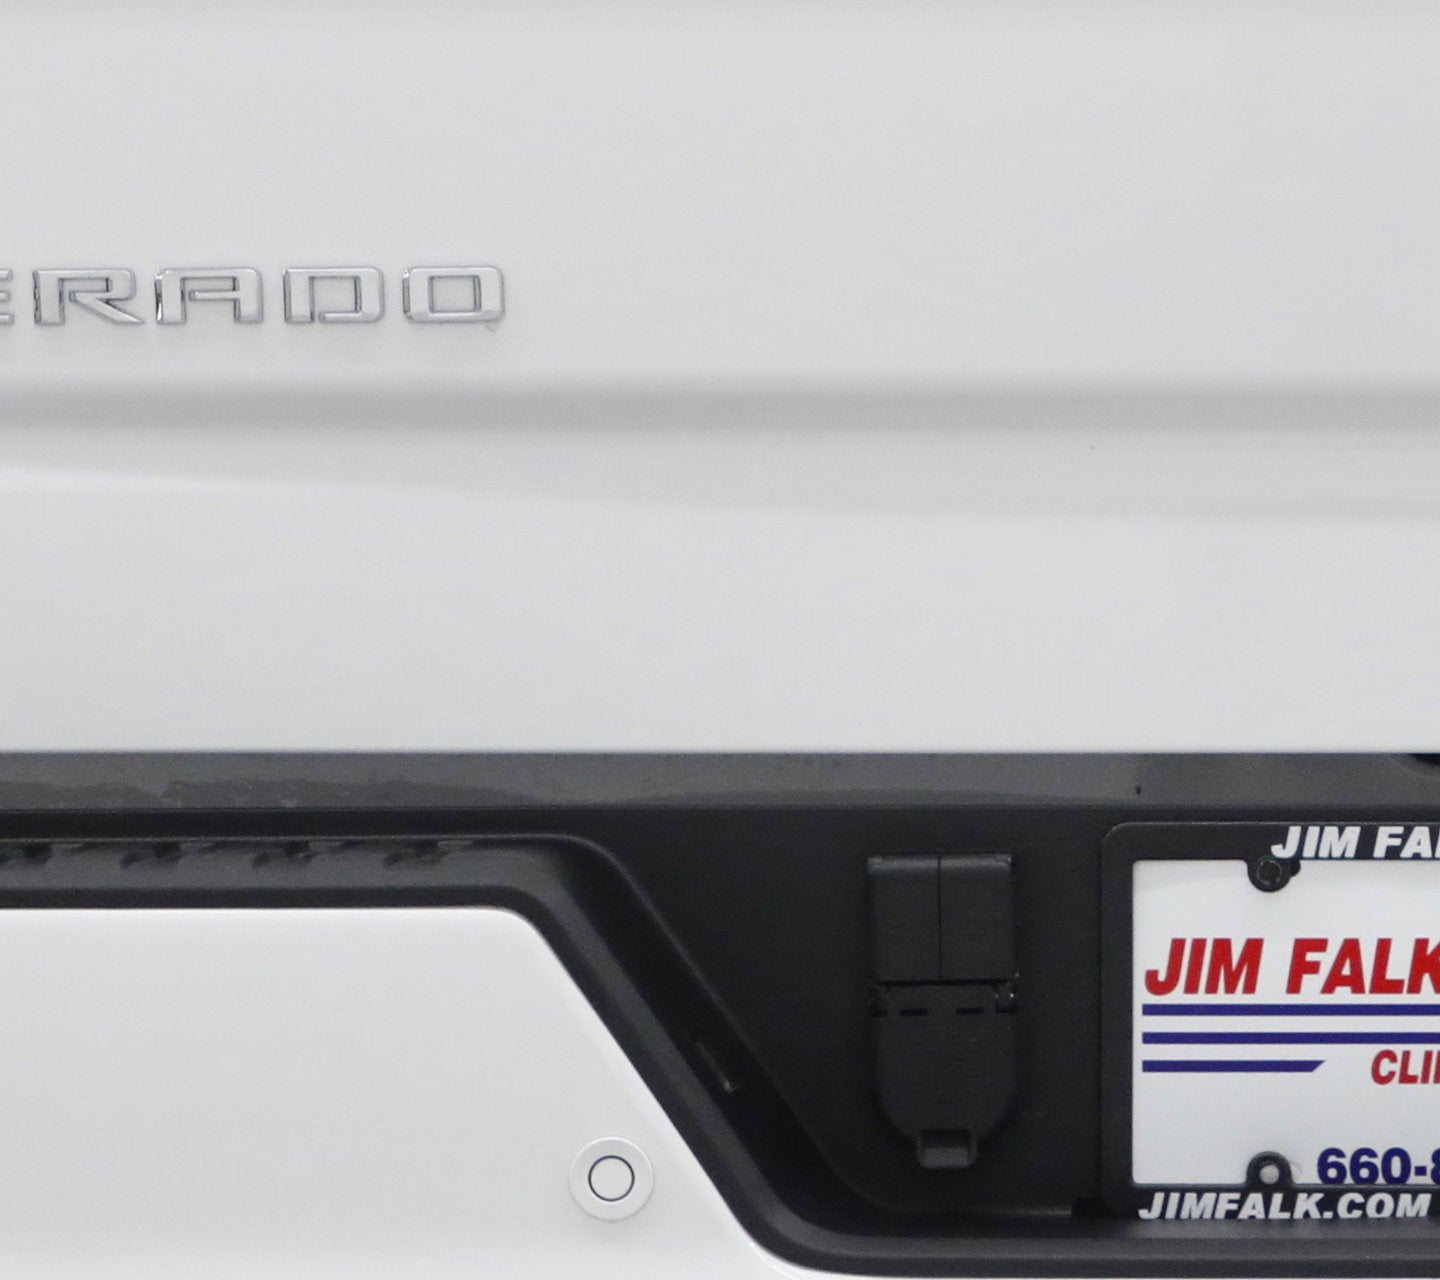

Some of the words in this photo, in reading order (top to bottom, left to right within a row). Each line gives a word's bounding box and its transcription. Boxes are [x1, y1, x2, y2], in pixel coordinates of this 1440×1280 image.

[1271, 826, 1360, 859] JIM
[1144, 937, 1264, 997] JIM
[1137, 1192, 1433, 1220] JIMFALK.COM
